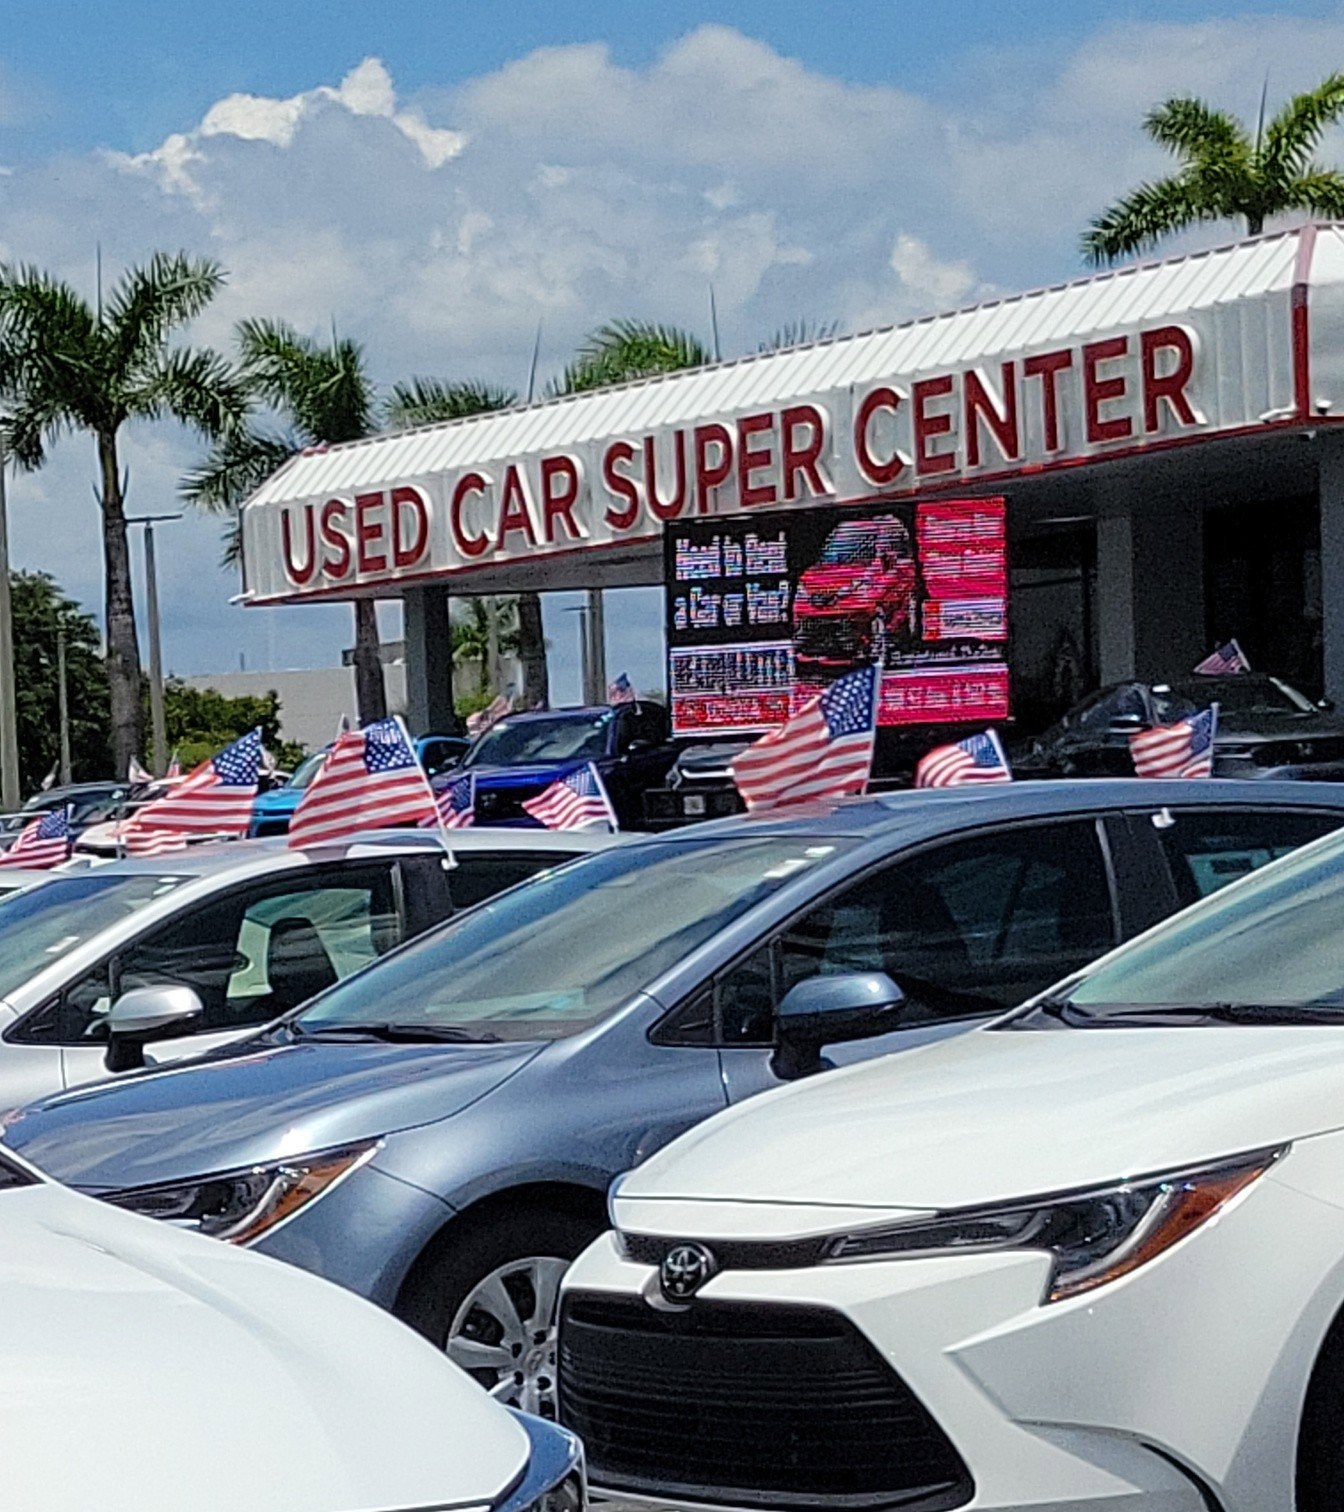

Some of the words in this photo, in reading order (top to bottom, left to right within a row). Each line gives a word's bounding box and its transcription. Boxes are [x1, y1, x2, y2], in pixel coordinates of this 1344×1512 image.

[280, 484, 429, 587] USED
[448, 454, 582, 559] CAR
[602, 403, 831, 530] SUPER
[854, 324, 1197, 485] CENTER
